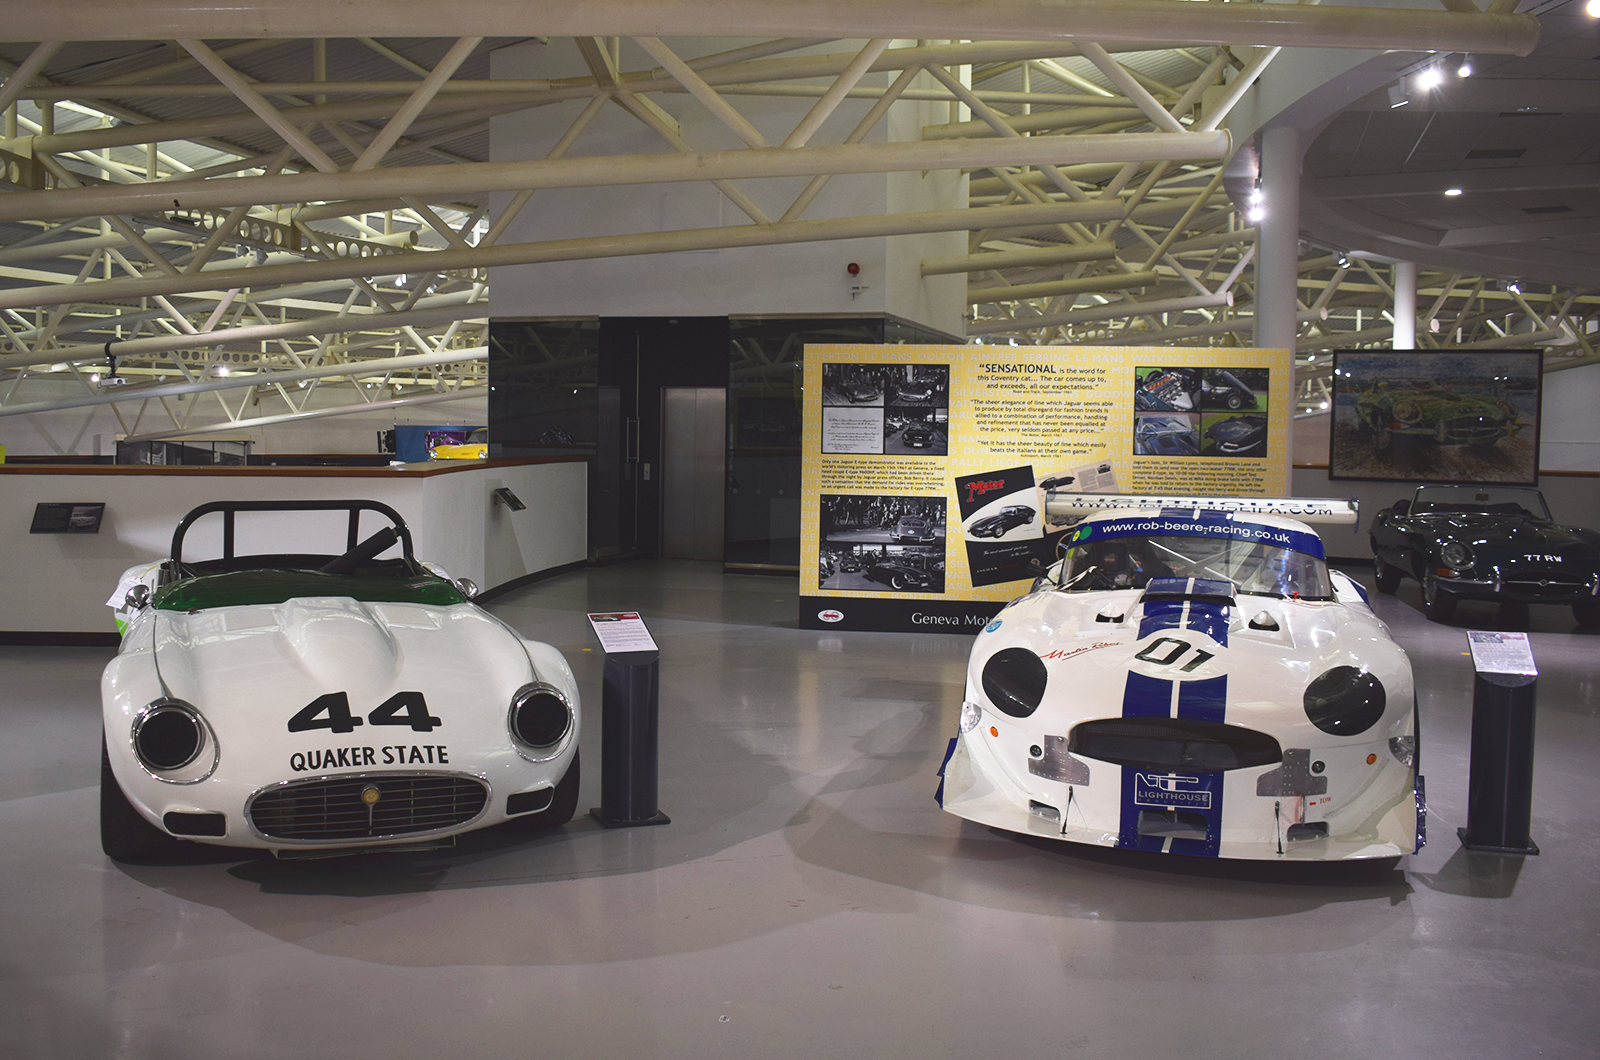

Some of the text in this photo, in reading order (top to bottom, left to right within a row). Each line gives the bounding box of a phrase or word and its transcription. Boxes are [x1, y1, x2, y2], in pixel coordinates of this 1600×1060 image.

[864, 353, 877, 361] LE
[880, 353, 912, 361] MANS
[917, 353, 964, 361] OULTON
[970, 353, 1017, 361] AINTREE
[1023, 353, 1070, 362] SEBRING
[1075, 354, 1088, 362] LE
[1092, 354, 1124, 362] MANS
[1132, 354, 1182, 363] WATKINS
[1187, 354, 1217, 363] GLEN
[1226, 355, 1257, 363] TOUR
[1262, 355, 1276, 363] DE
[979, 363, 1056, 373] “SENSATIONAL
[965, 480, 1005, 502] Motor
[1102, 521, 1290, 544] www.rob-beere-racing.co.uk
[911, 612, 959, 626] Geneva
[1134, 637, 1216, 673] 01
[288, 691, 442, 733] 44
[290, 745, 449, 772] QUAKER STATE
[1138, 790, 1208, 802] LIGHTHOUSE
